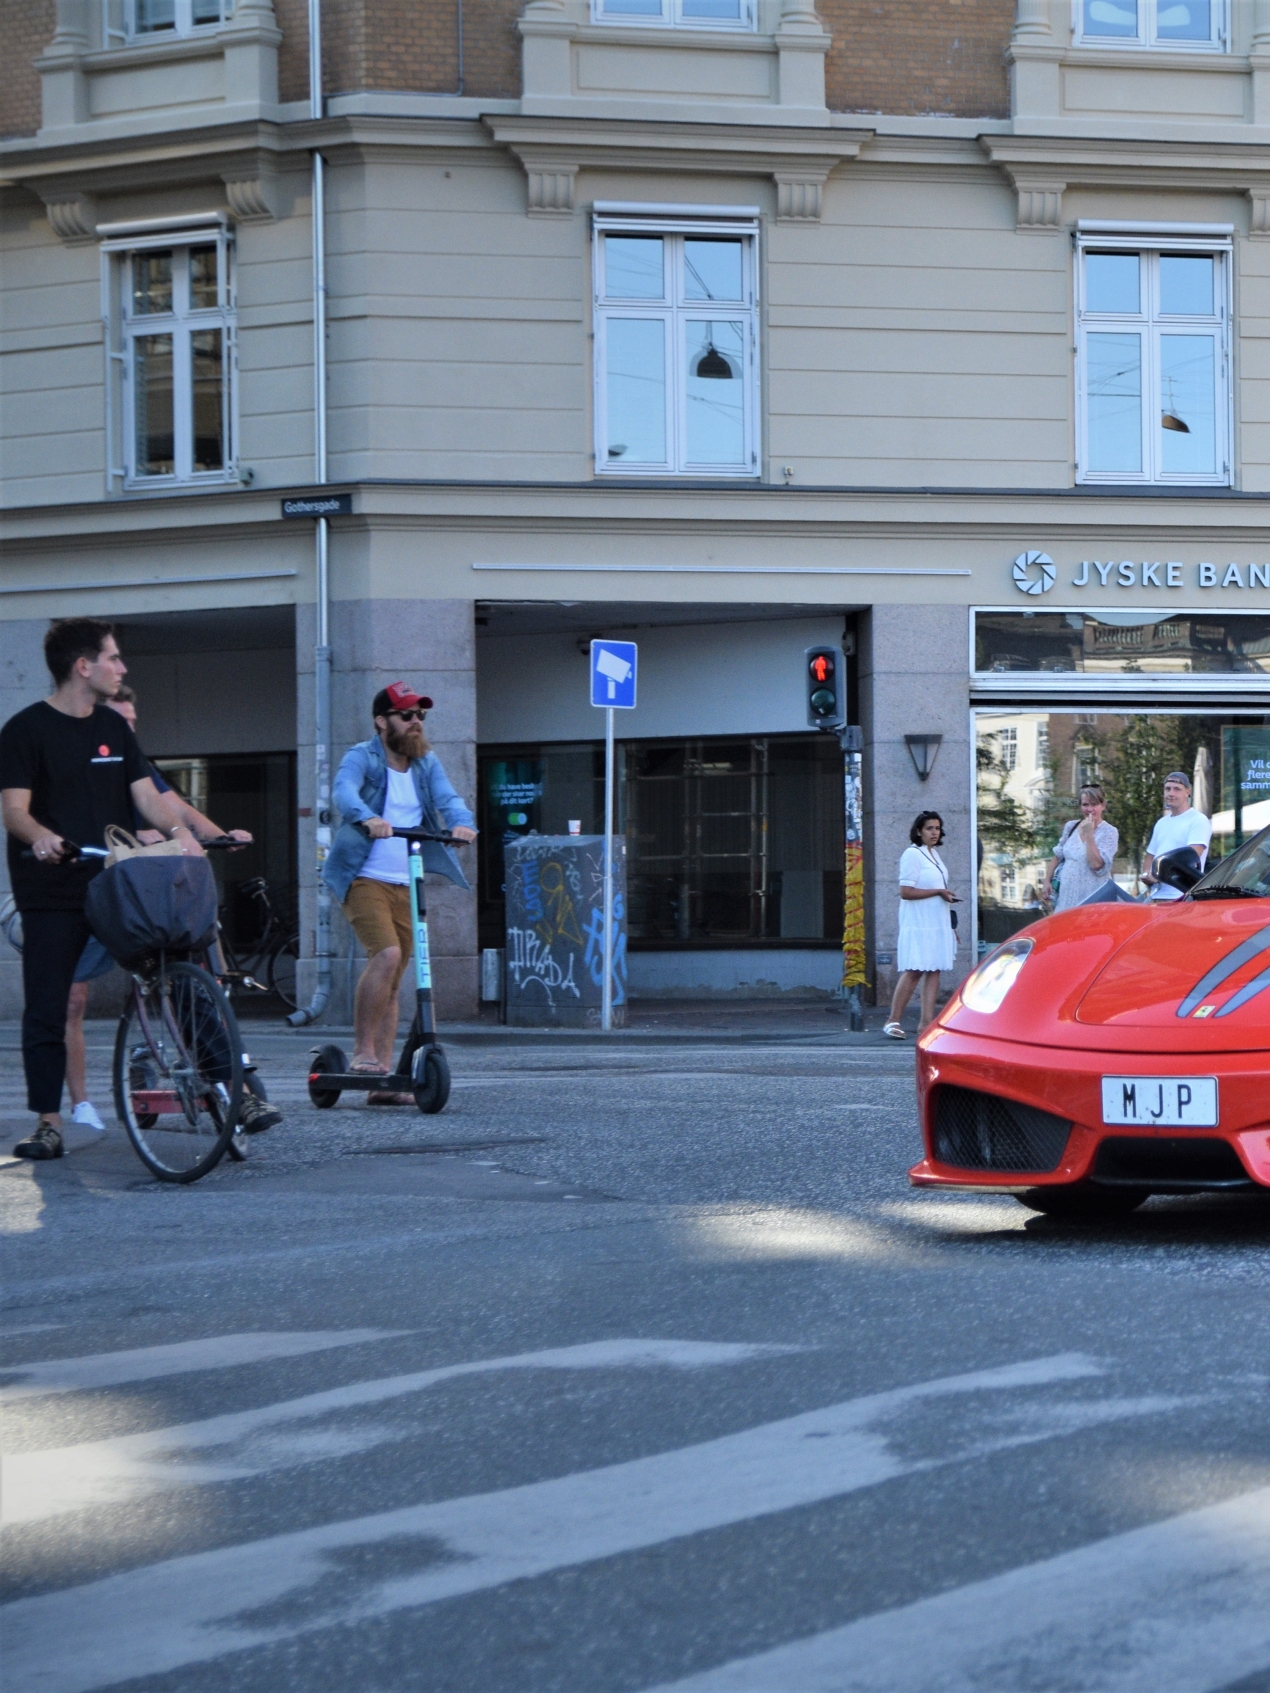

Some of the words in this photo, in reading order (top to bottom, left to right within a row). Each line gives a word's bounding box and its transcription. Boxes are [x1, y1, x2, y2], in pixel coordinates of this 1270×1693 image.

[284, 500, 340, 513] Gothersgade
[1072, 561, 1185, 587] JYSKE
[1250, 760, 1264, 769] Vil
[417, 928, 431, 983] TIER
